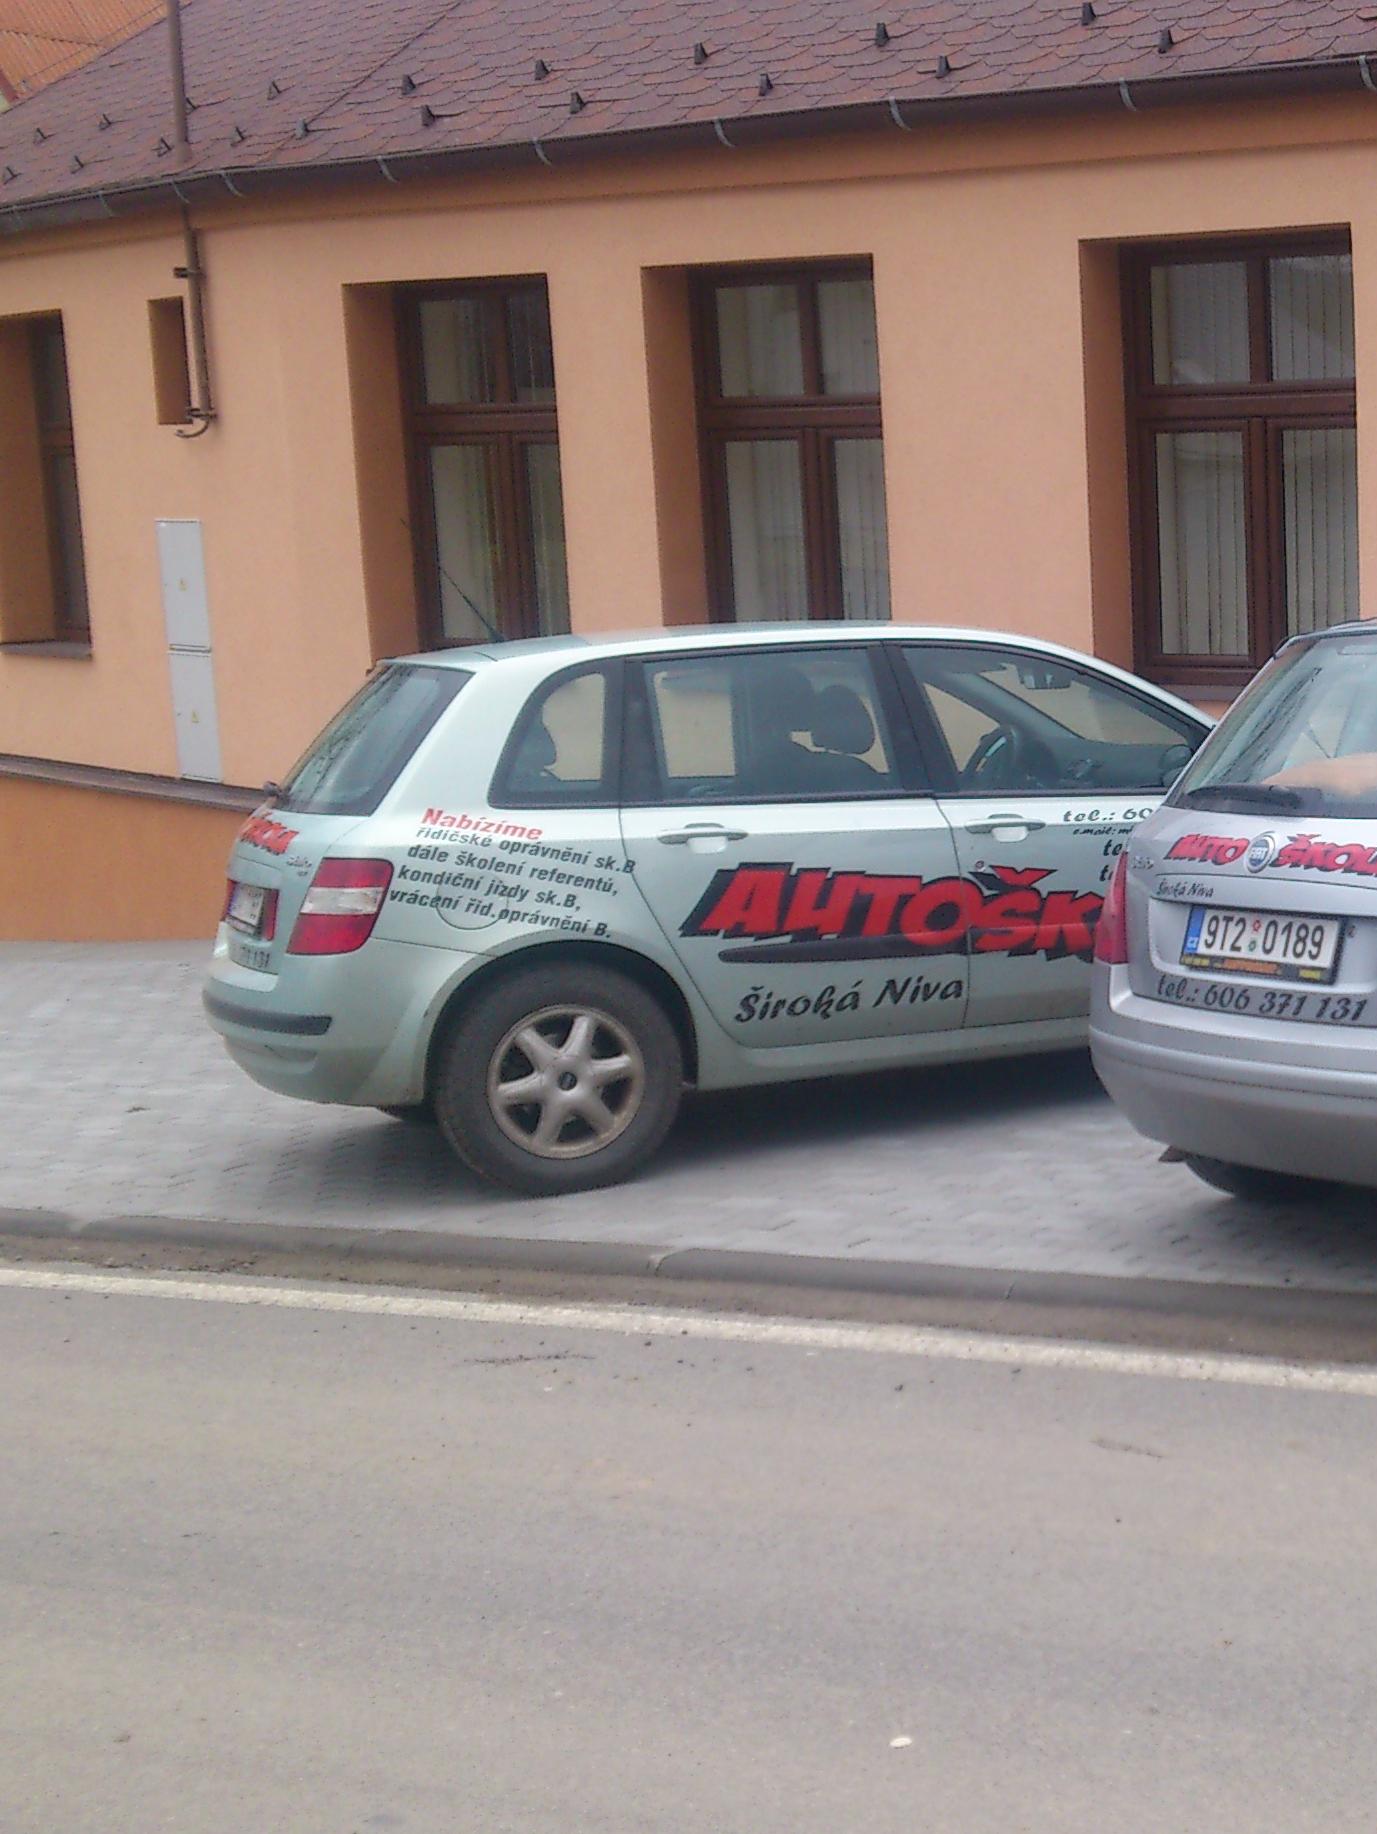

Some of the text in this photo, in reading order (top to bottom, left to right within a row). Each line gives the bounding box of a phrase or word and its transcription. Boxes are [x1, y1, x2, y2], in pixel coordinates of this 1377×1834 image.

[422, 807, 543, 840] Nabízíme
[407, 843, 449, 863] dále
[455, 850, 526, 876] školení
[416, 826, 493, 848] řidičské
[499, 838, 592, 866] oprávnění
[1163, 833, 1251, 866] AUTO
[398, 864, 485, 892] kondiční
[389, 888, 464, 911] vrácení
[1204, 913, 1325, 961] 9T2 0189
[734, 974, 964, 1024] Široká Niva
[1157, 973, 1368, 1022] tel.: 606 371 131
